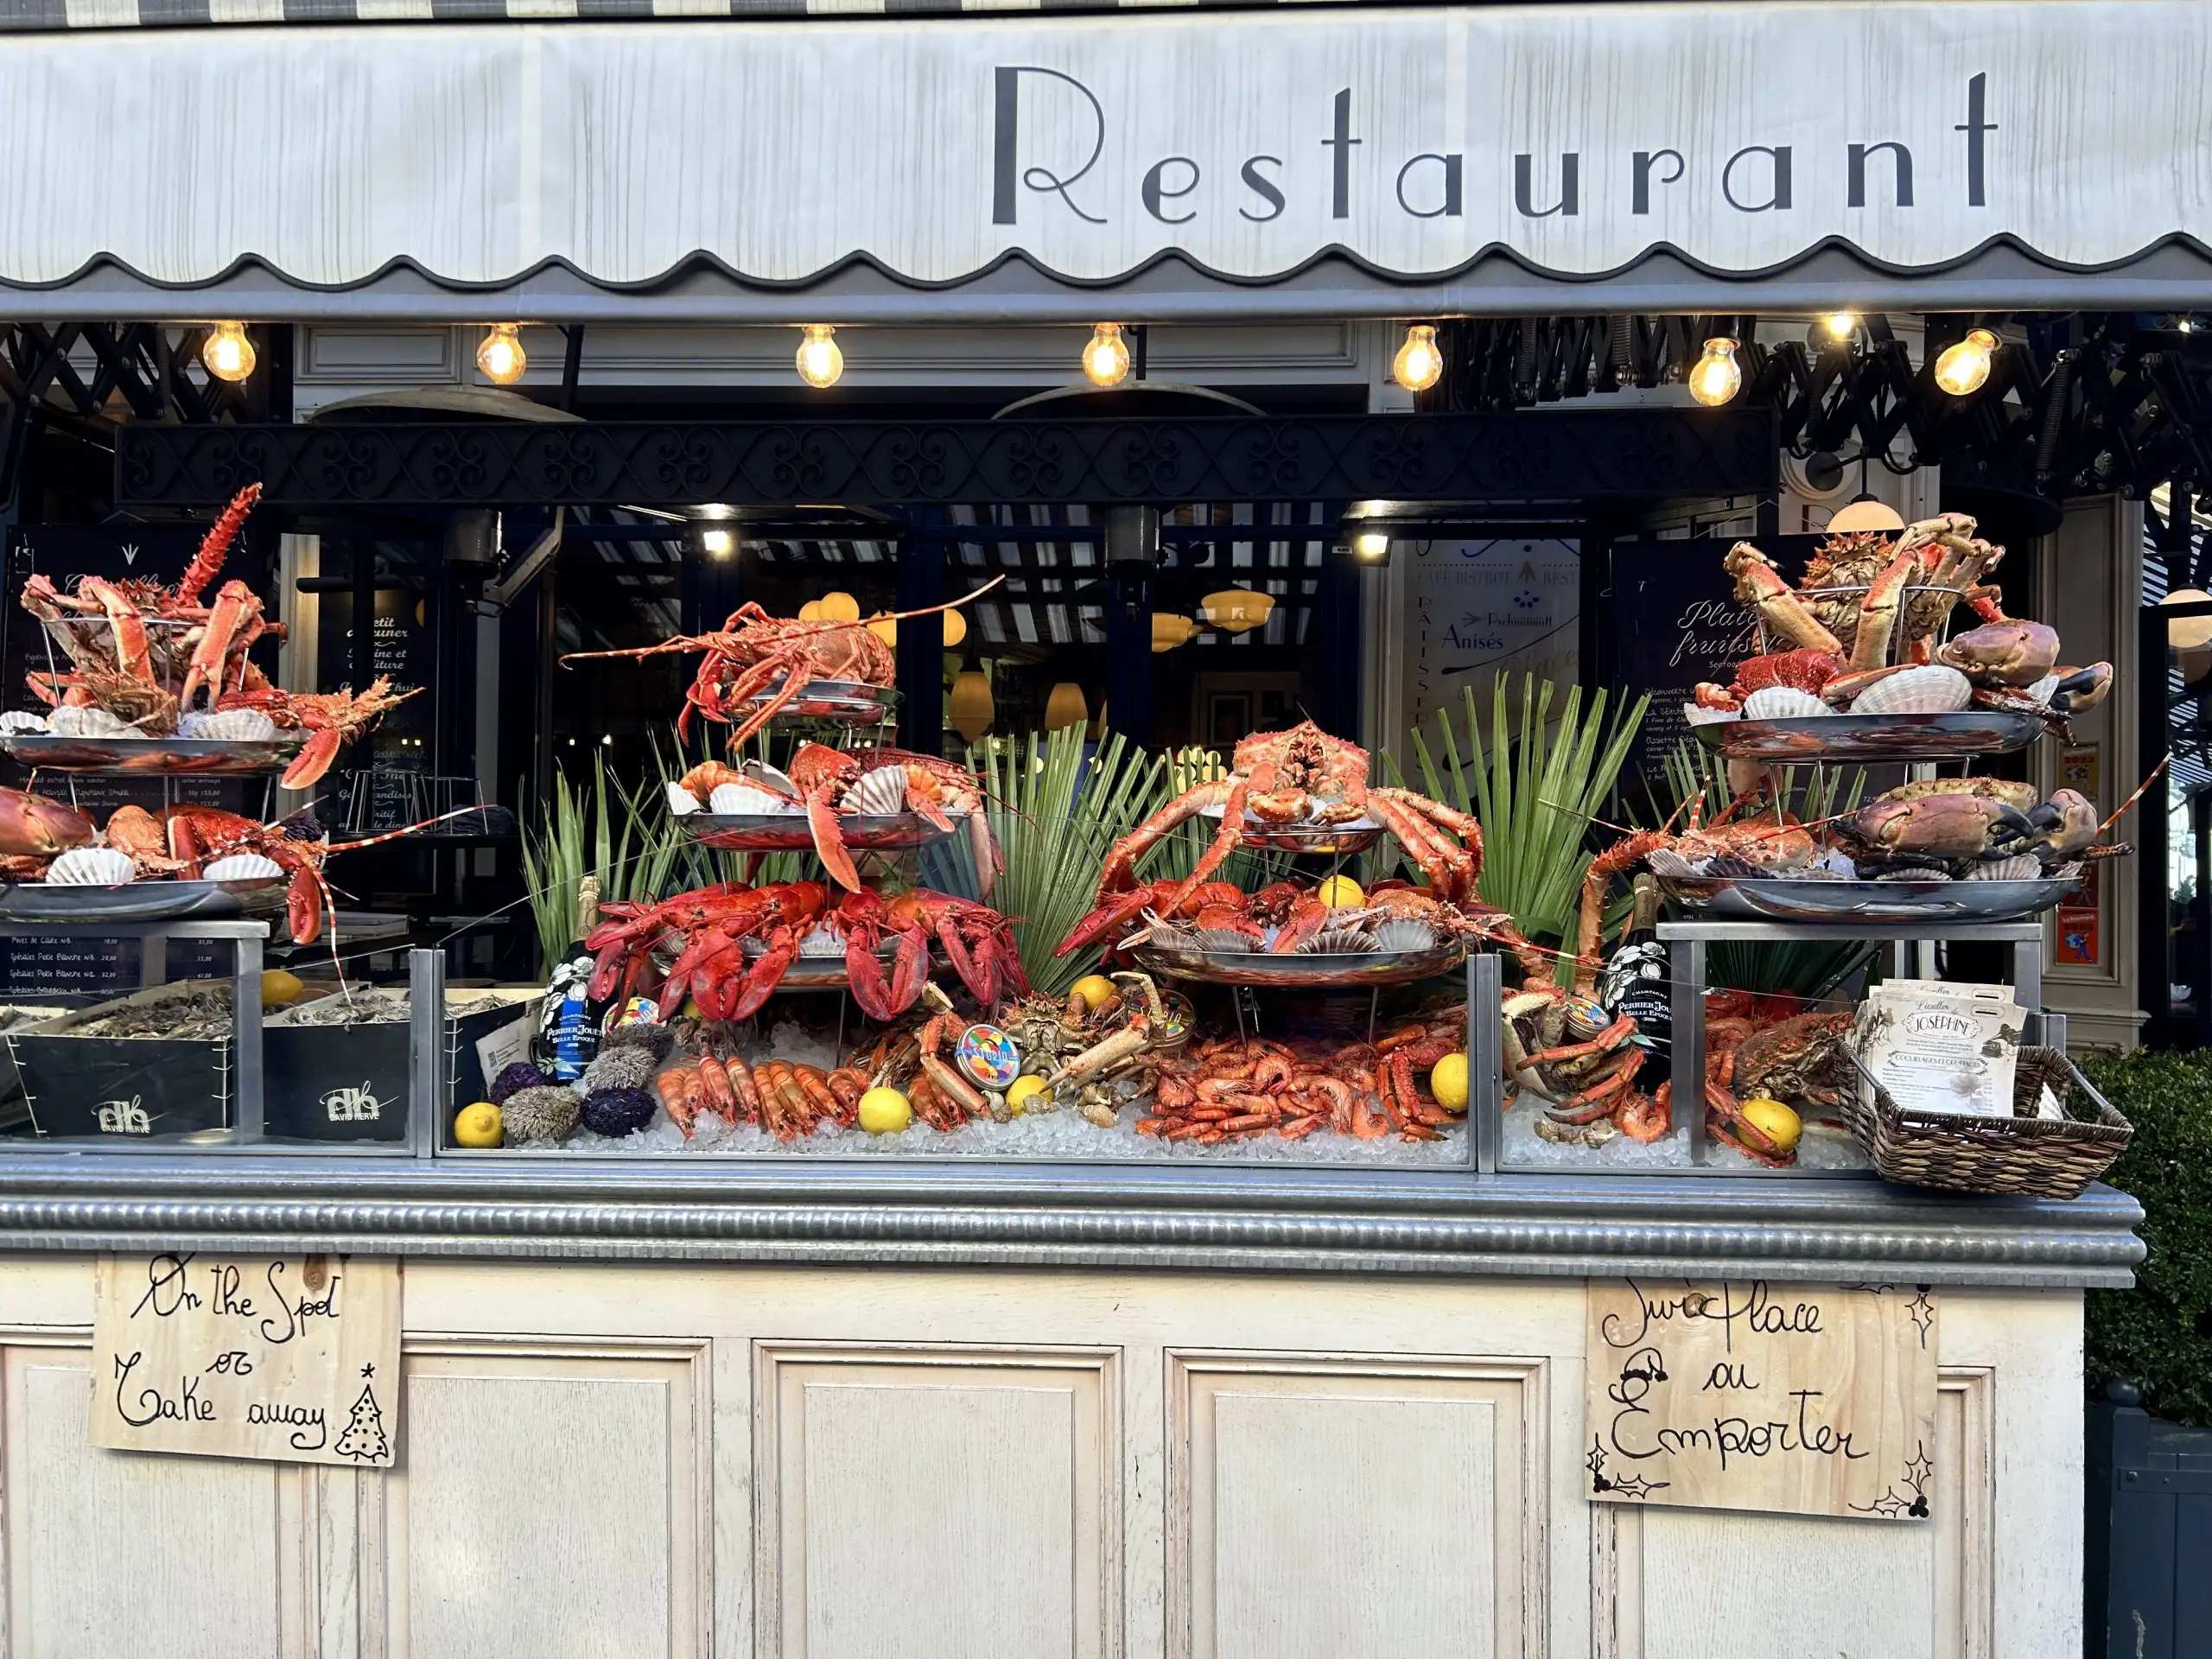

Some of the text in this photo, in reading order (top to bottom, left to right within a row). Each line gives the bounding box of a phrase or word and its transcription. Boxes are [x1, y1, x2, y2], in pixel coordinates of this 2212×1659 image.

[993, 67, 1999, 226] Restaurant
[1442, 624, 1503, 649] Anisés
[211, 1264, 258, 1316] the
[114, 1351, 217, 1427] Take
[206, 1351, 253, 1376] or
[246, 1403, 327, 1450] away
[1609, 1377, 1870, 1471] Emporter
